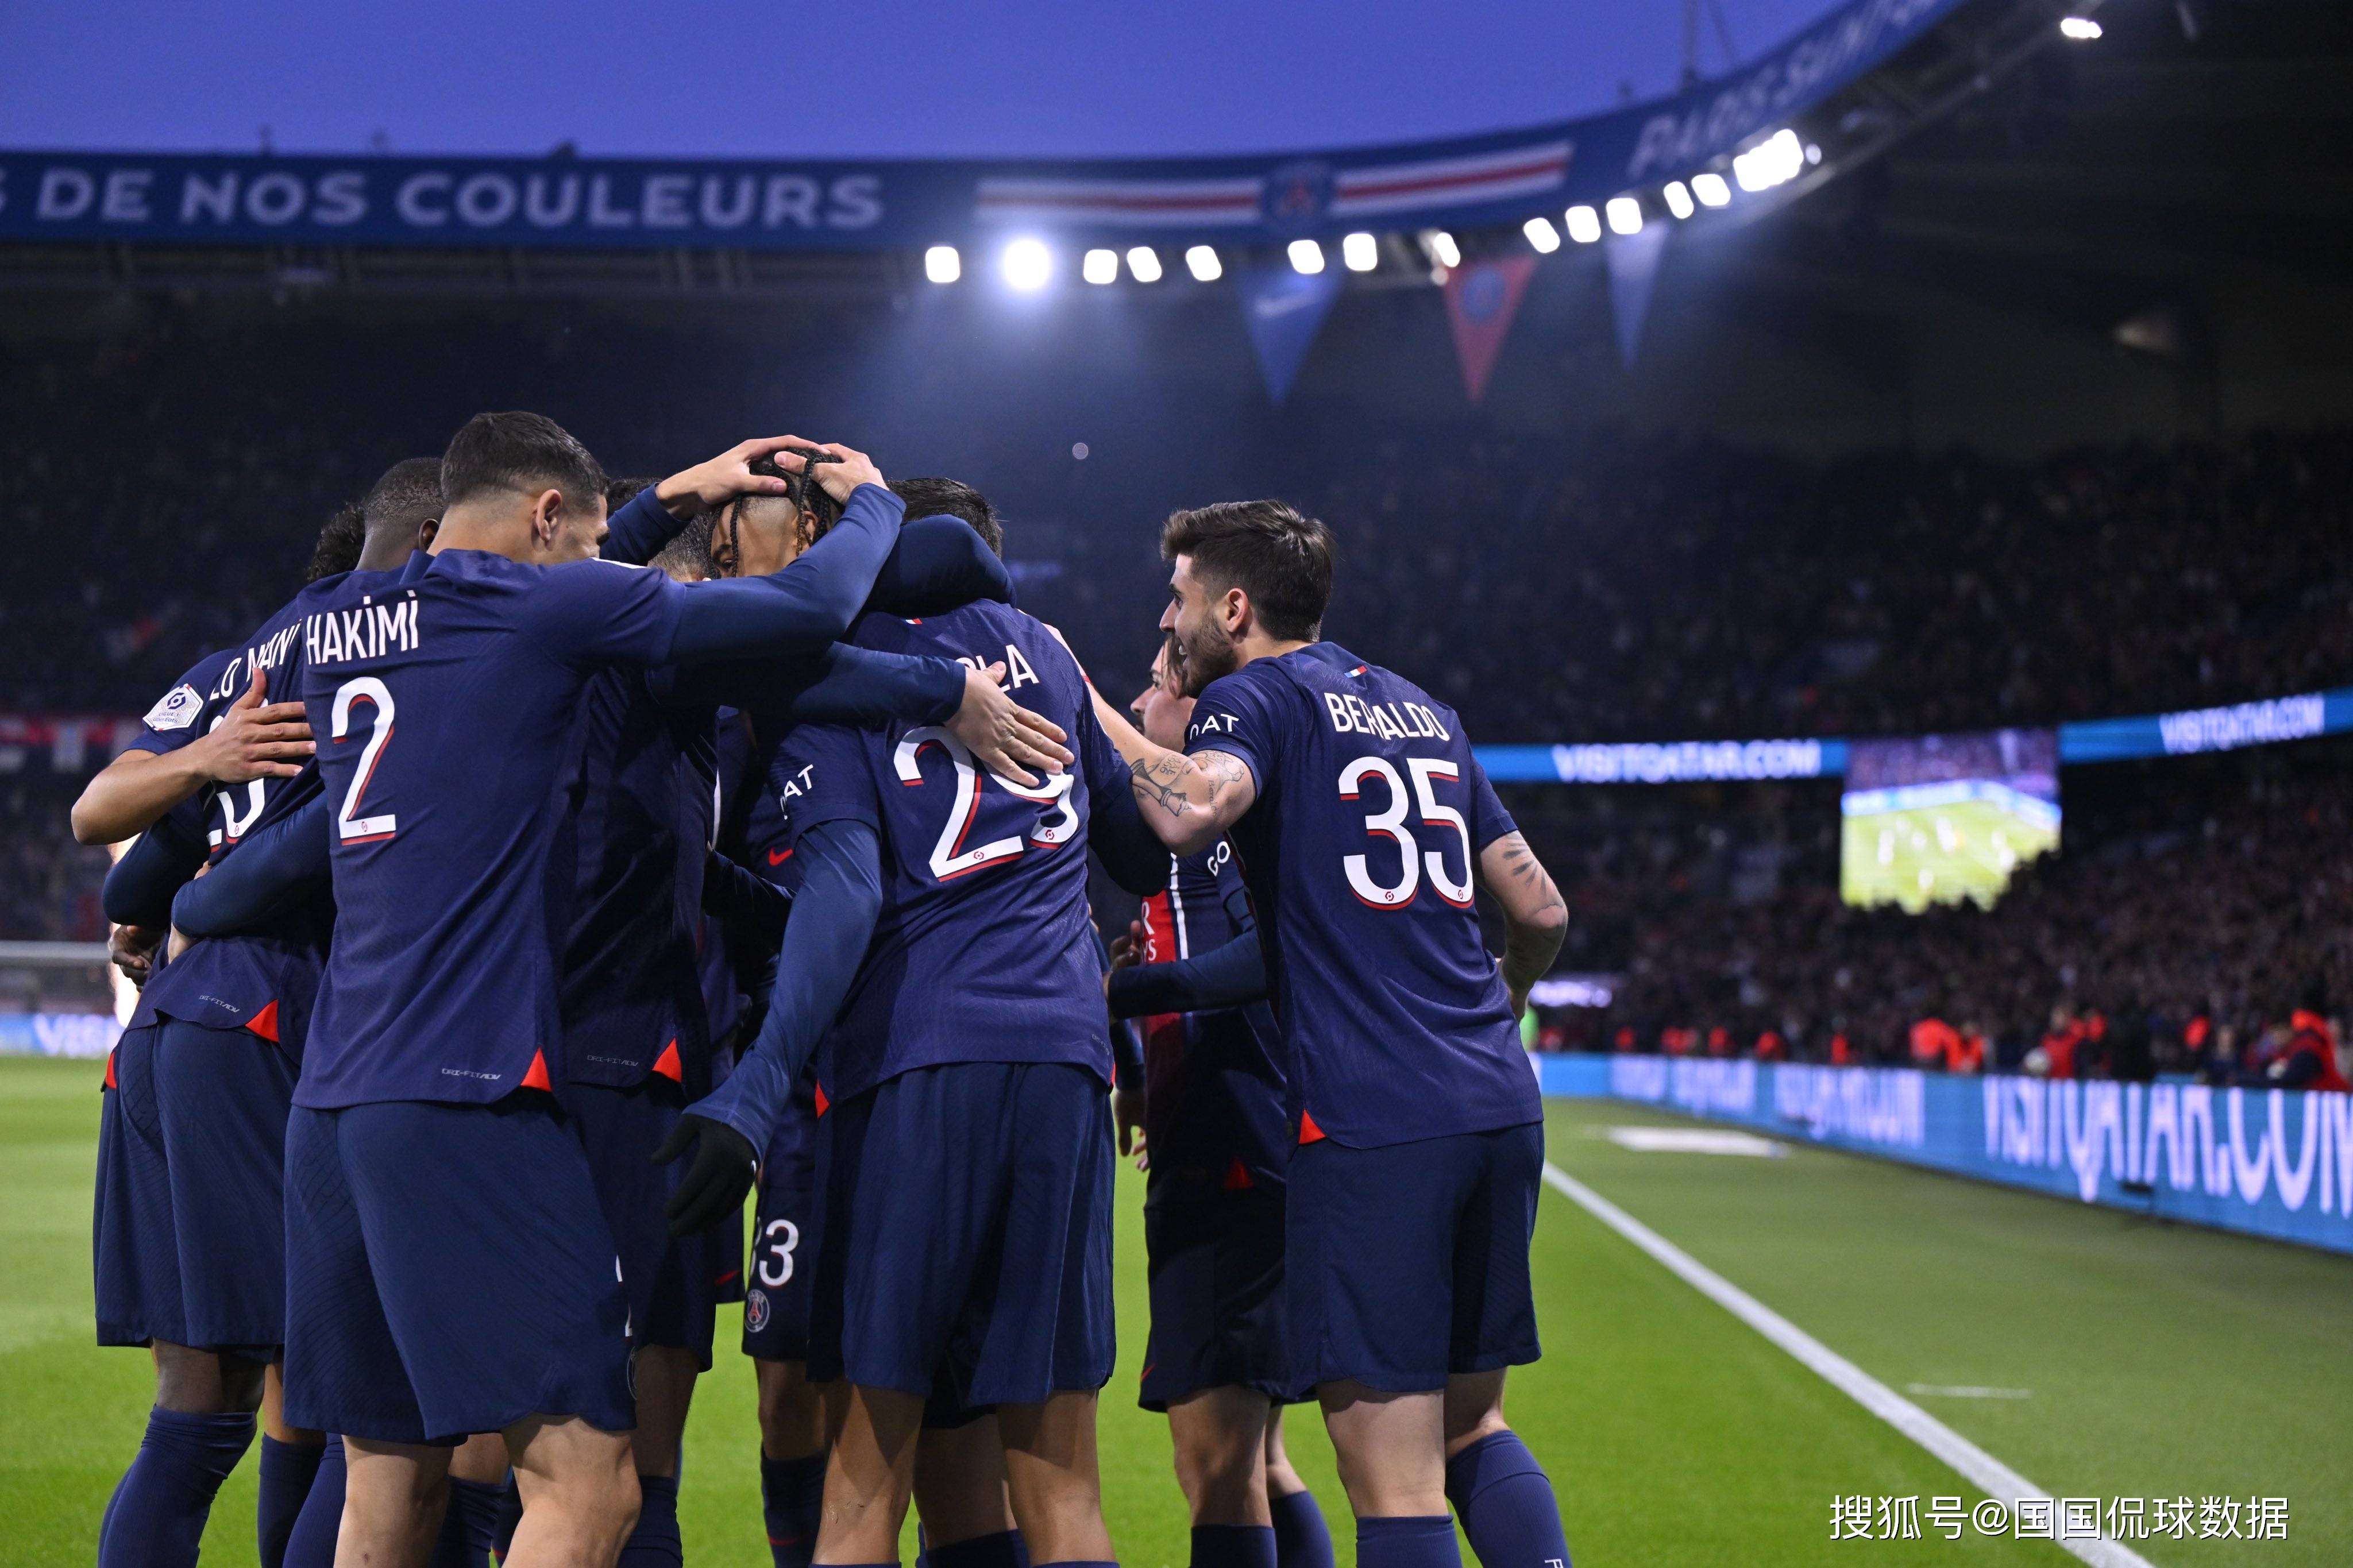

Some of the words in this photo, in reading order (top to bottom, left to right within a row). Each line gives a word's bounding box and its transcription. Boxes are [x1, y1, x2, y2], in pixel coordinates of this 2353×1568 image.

[37, 168, 154, 219] DE
[179, 172, 369, 225] NOS
[394, 173, 882, 227] COULEURS
[1324, 693, 1450, 741] BERALDO
[331, 677, 396, 844] 2
[1338, 756, 1473, 907] 35
[750, 1216, 799, 1288] 3
